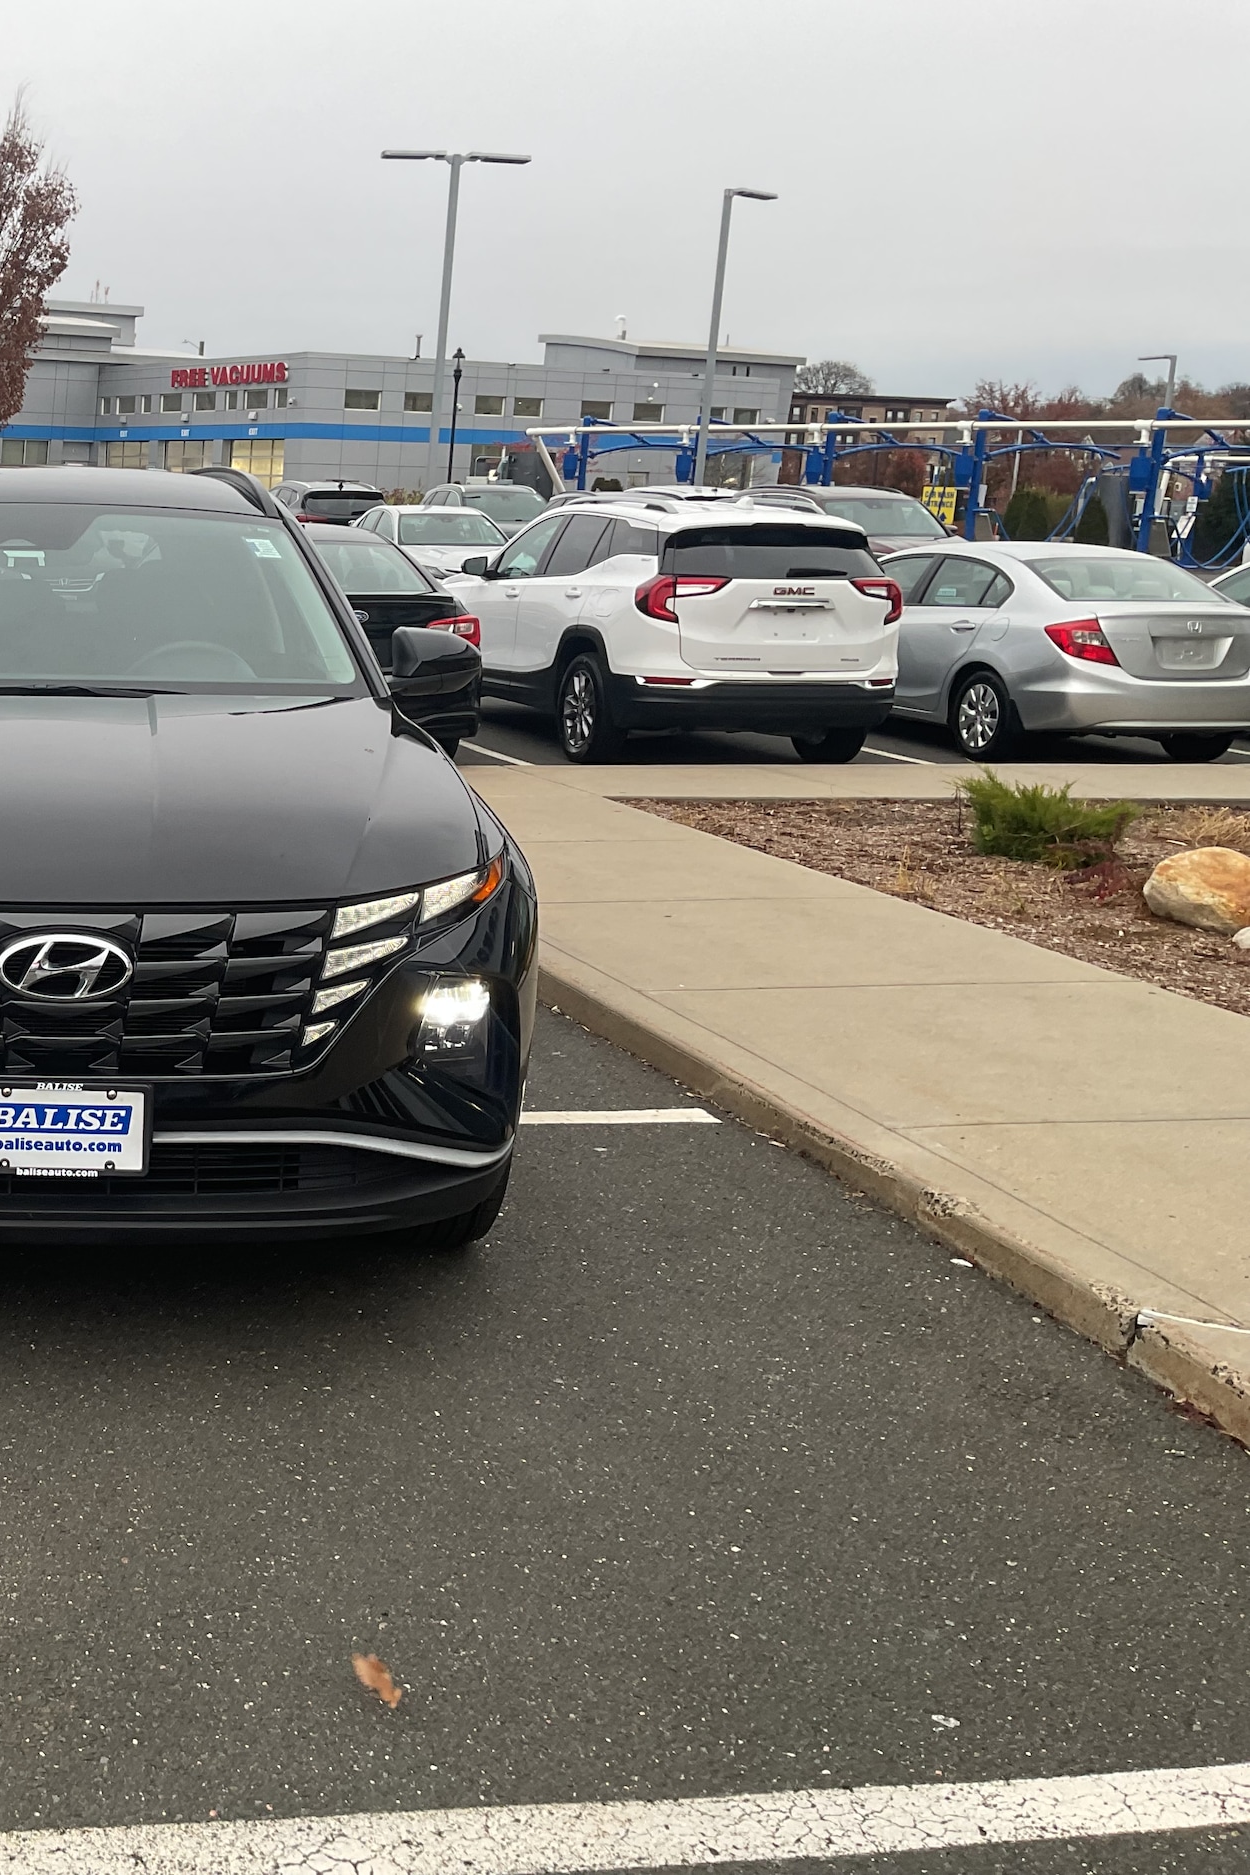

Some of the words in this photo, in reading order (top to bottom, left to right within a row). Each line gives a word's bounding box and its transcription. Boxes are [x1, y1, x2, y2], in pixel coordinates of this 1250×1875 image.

[171, 368, 208, 388] FREE
[211, 362, 289, 386] VACUUMS
[773, 587, 815, 596] GMC
[36, 1082, 84, 1092] BALISE
[16, 1167, 98, 1178] baliseauto.com
